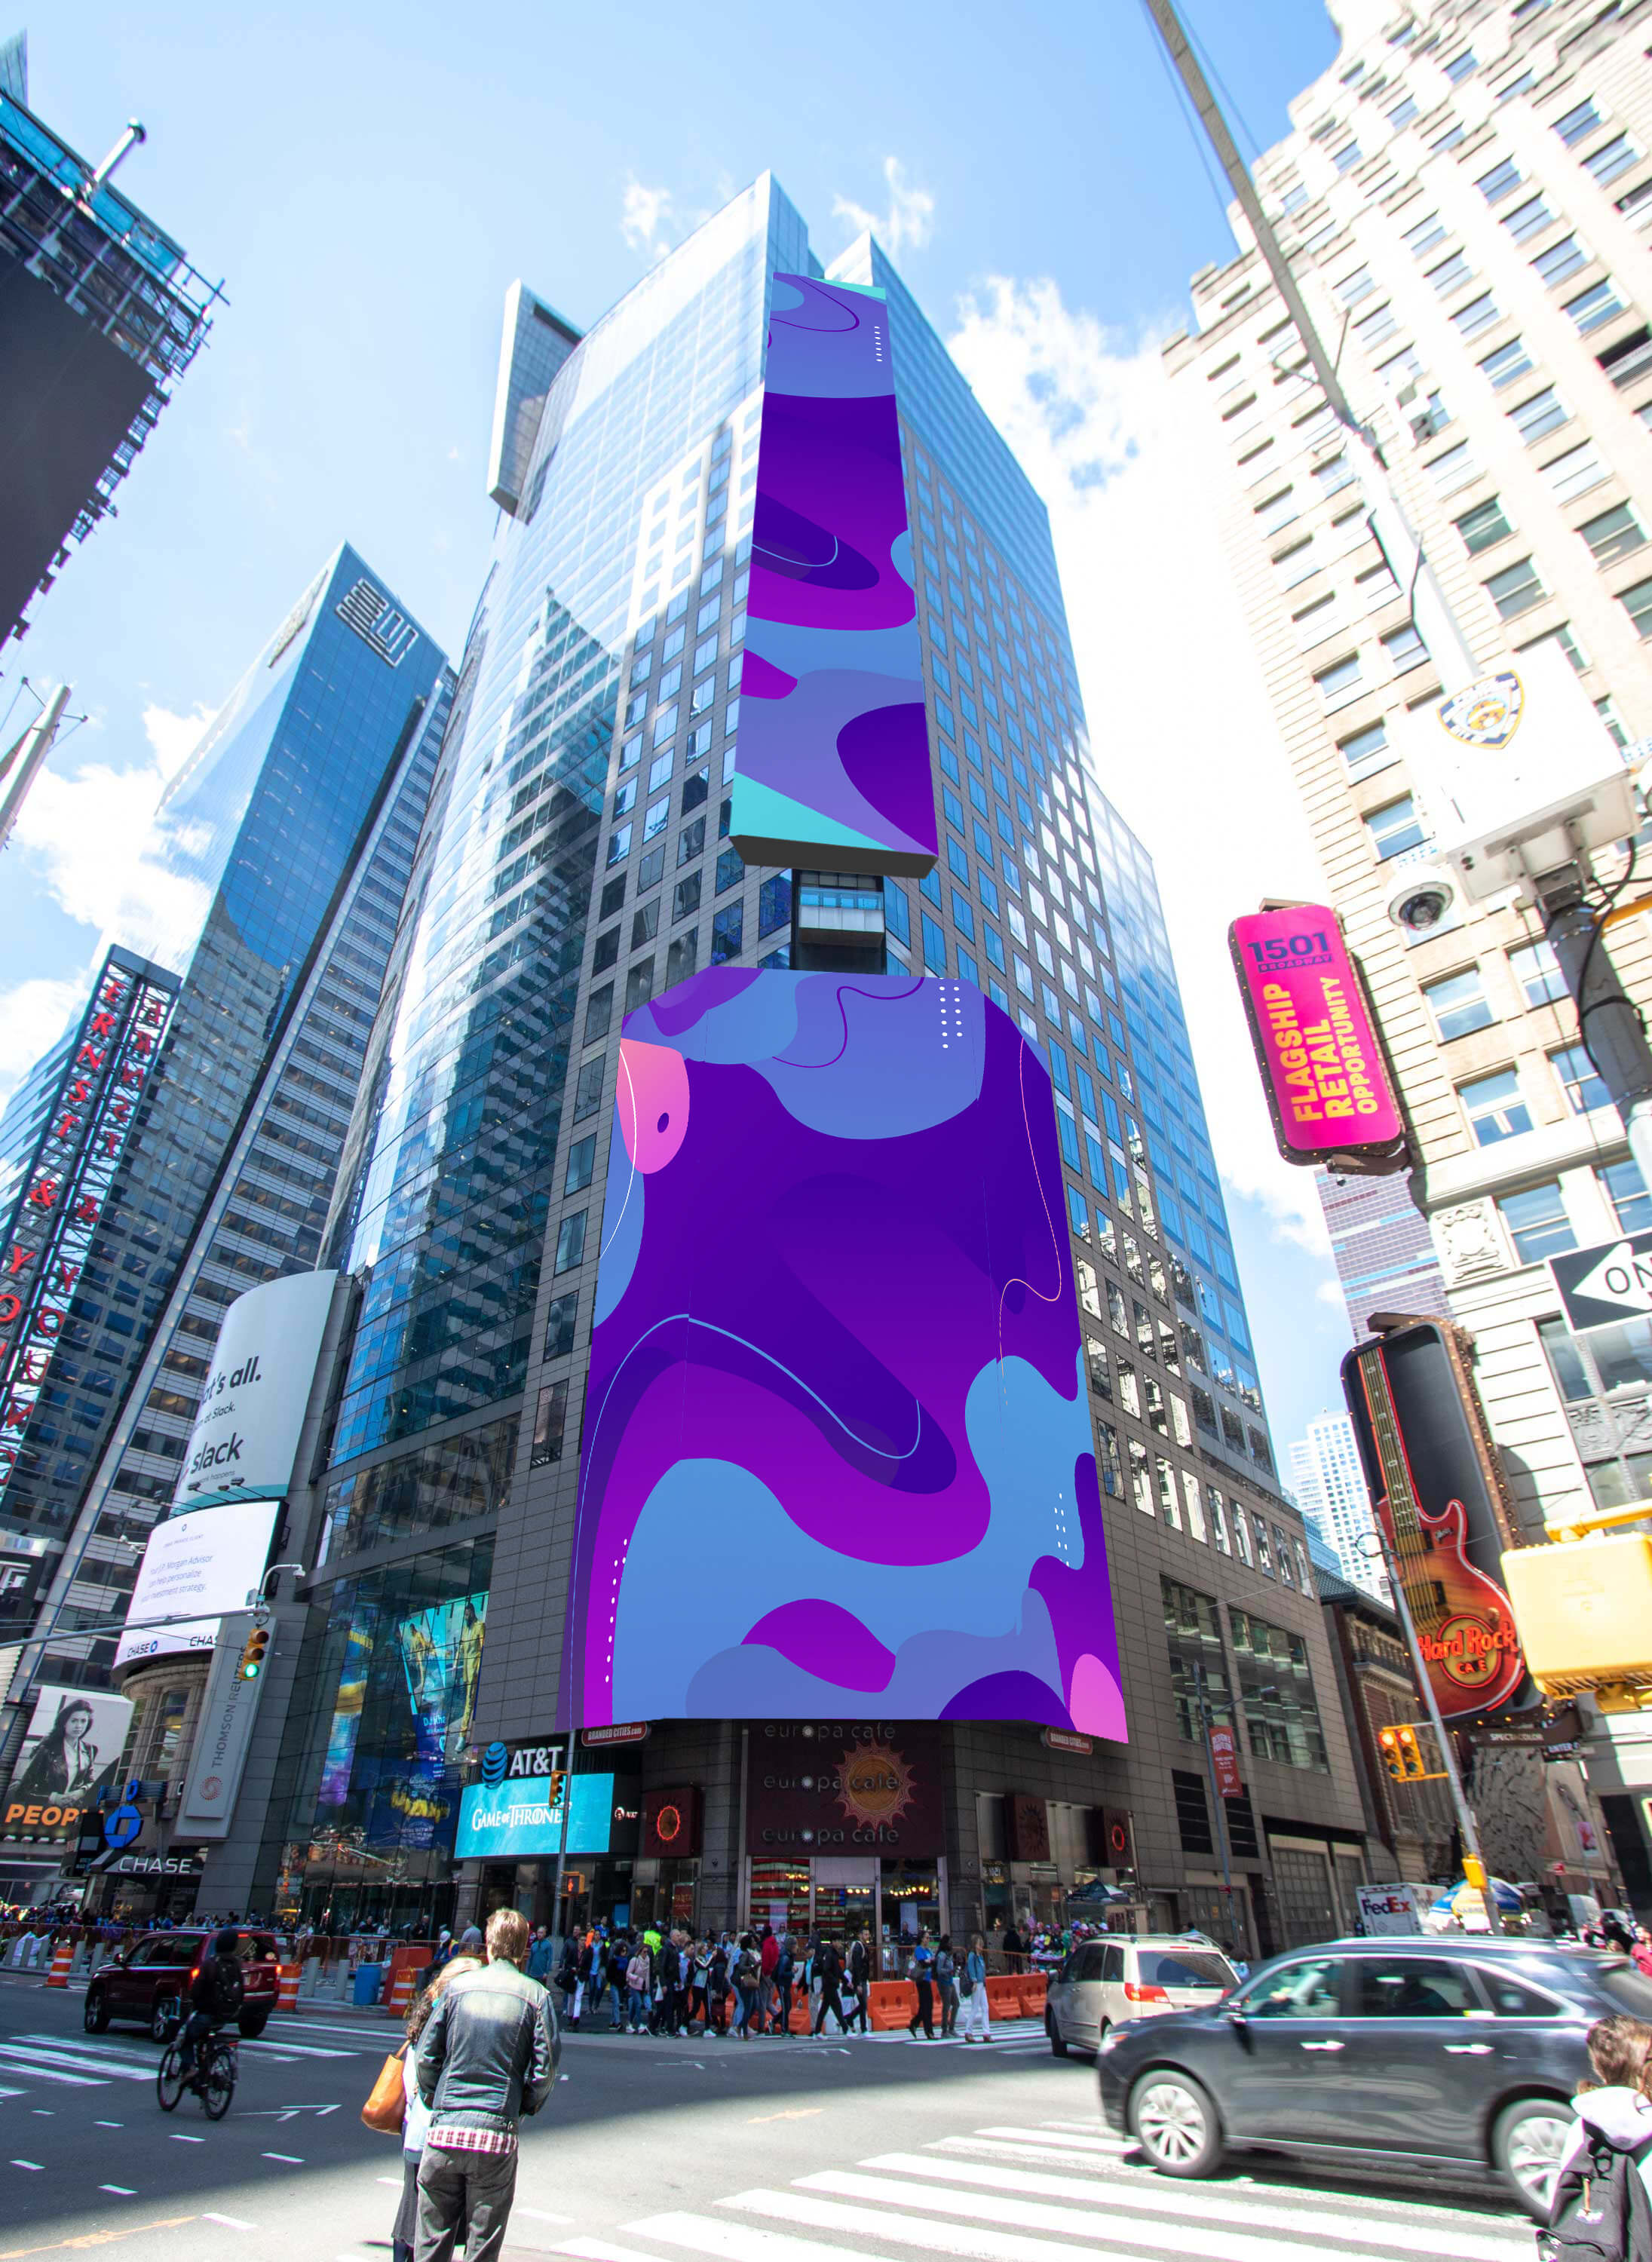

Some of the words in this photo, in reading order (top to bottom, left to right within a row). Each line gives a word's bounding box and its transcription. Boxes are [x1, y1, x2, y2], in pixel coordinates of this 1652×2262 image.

[1248, 933, 1329, 962] 1501
[1258, 955, 1332, 973] BROADWAY
[56, 980, 126, 1138] ERNST
[1263, 983, 1323, 1122] FLAGSHIP
[1319, 976, 1378, 1114] OPPORTUNITY
[1304, 1019, 1355, 1118] RETAIL
[29, 1179, 58, 1209] &
[229, 1356, 261, 1388] all.
[212, 1401, 236, 1419] Slack.
[190, 1432, 244, 1474] slack
[127, 1641, 151, 1658] CHASE
[1417, 1630, 1464, 1662] Hard
[1465, 1623, 1521, 1658] Rock
[211, 1704, 236, 1768] THOMSON
[509, 1746, 564, 1776] AT&T
[5, 1804, 89, 1826] PEOP
[472, 1808, 502, 1831] GAME
[508, 1802, 572, 1828] THRONE
[119, 1857, 193, 1874] CHASE
[1361, 1896, 1412, 1916] FedEx
